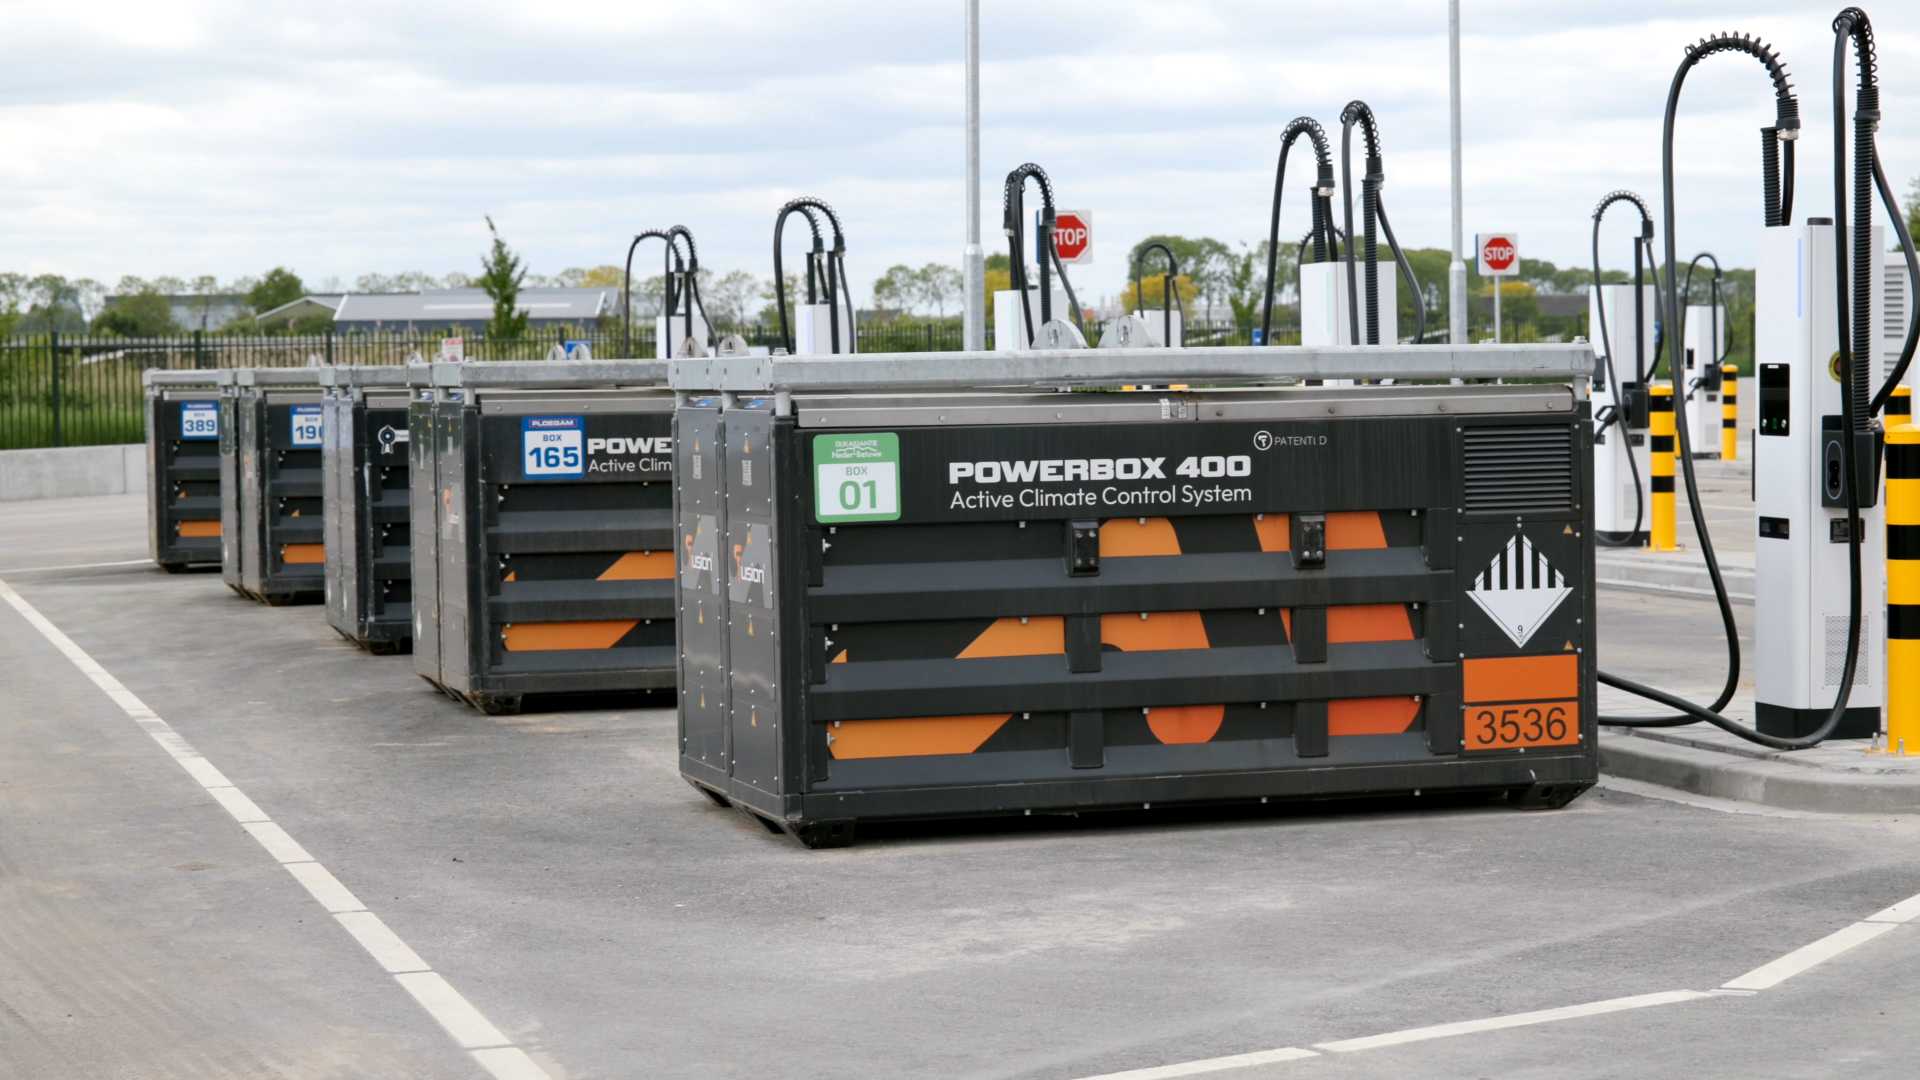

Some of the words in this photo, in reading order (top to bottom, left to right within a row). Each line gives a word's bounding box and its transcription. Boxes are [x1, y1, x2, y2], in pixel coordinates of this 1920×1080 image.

[1484, 247, 1514, 261] STOP
[184, 419, 216, 433] 389
[542, 434, 563, 442] BOX
[528, 447, 579, 468] 165
[588, 458, 635, 473] Active
[845, 465, 868, 477] BOX
[949, 456, 1167, 484] POWERBOX
[1175, 455, 1252, 479] 400
[839, 480, 877, 511] 01
[950, 489, 1014, 510] Active
[1019, 485, 1097, 508] Climate
[1102, 483, 1176, 506] Control
[1182, 484, 1252, 508] System
[1476, 707, 1567, 745] 3536
